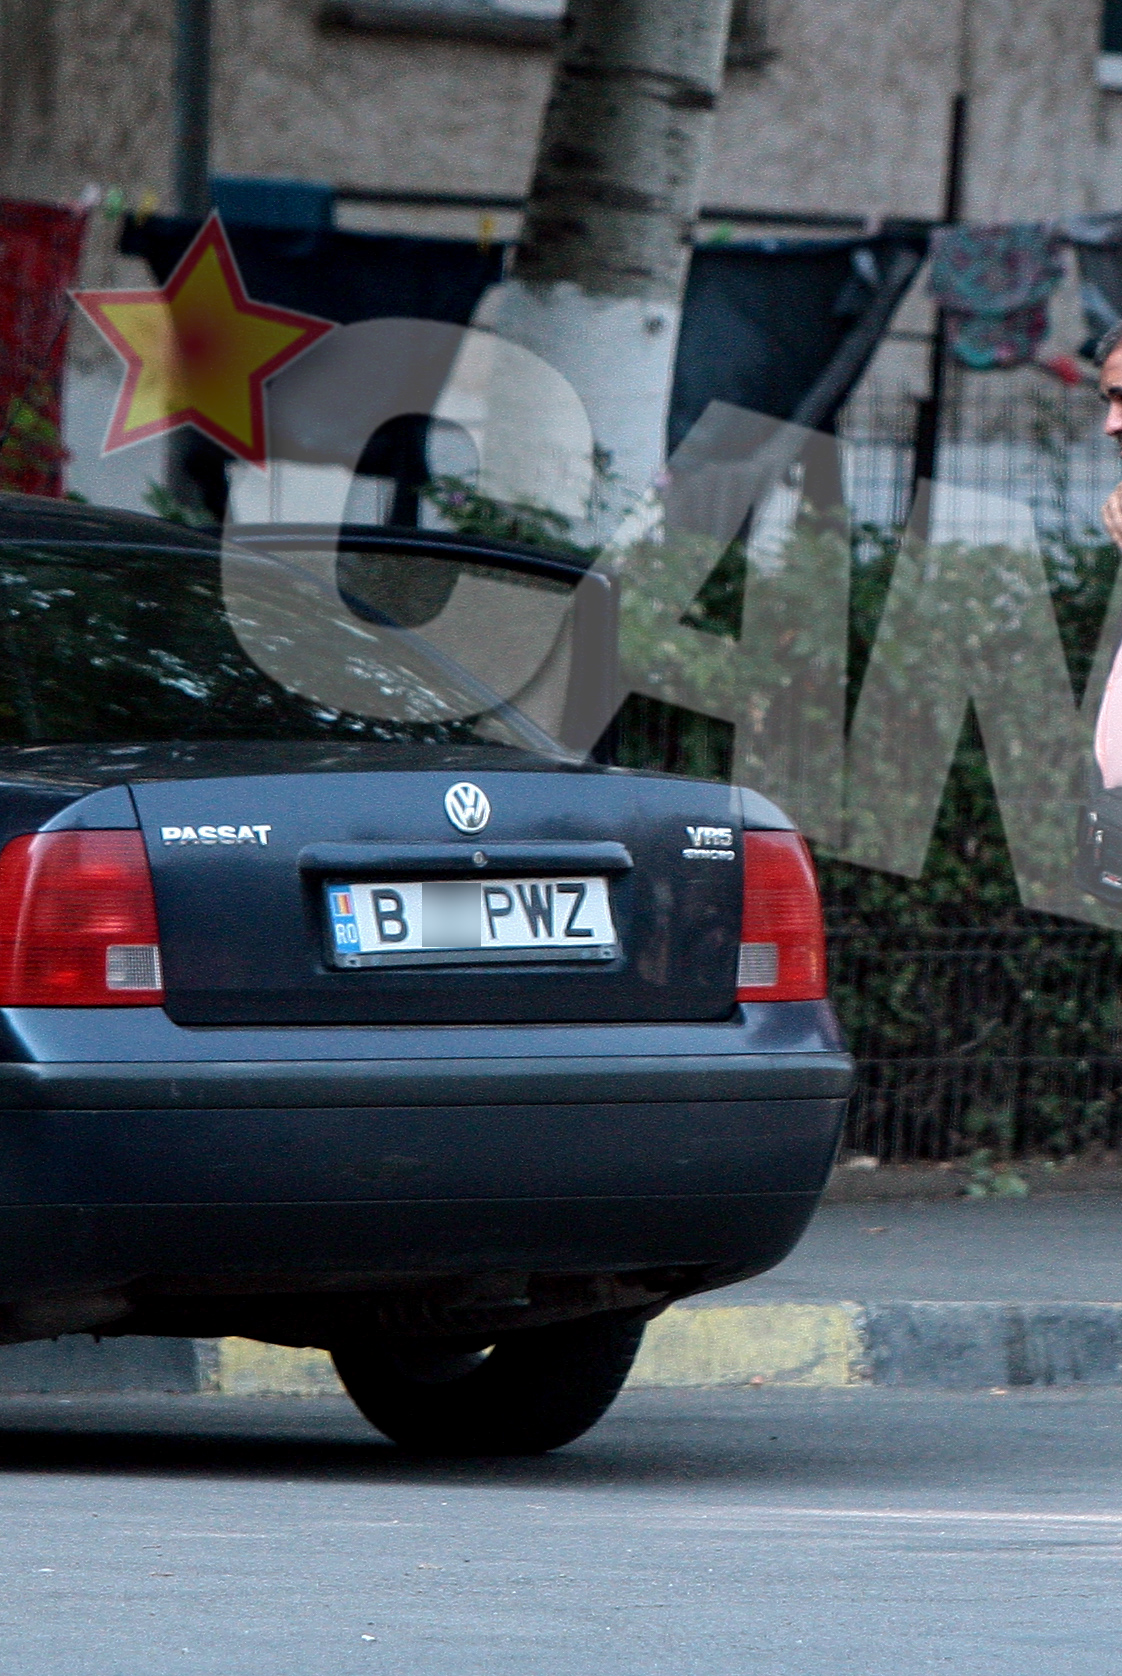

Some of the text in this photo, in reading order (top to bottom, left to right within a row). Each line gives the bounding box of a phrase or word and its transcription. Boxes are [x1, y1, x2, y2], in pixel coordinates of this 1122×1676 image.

[160, 824, 272, 846] PASSAT
[371, 882, 595, 944] B PWZ
[335, 923, 359, 945] RO
